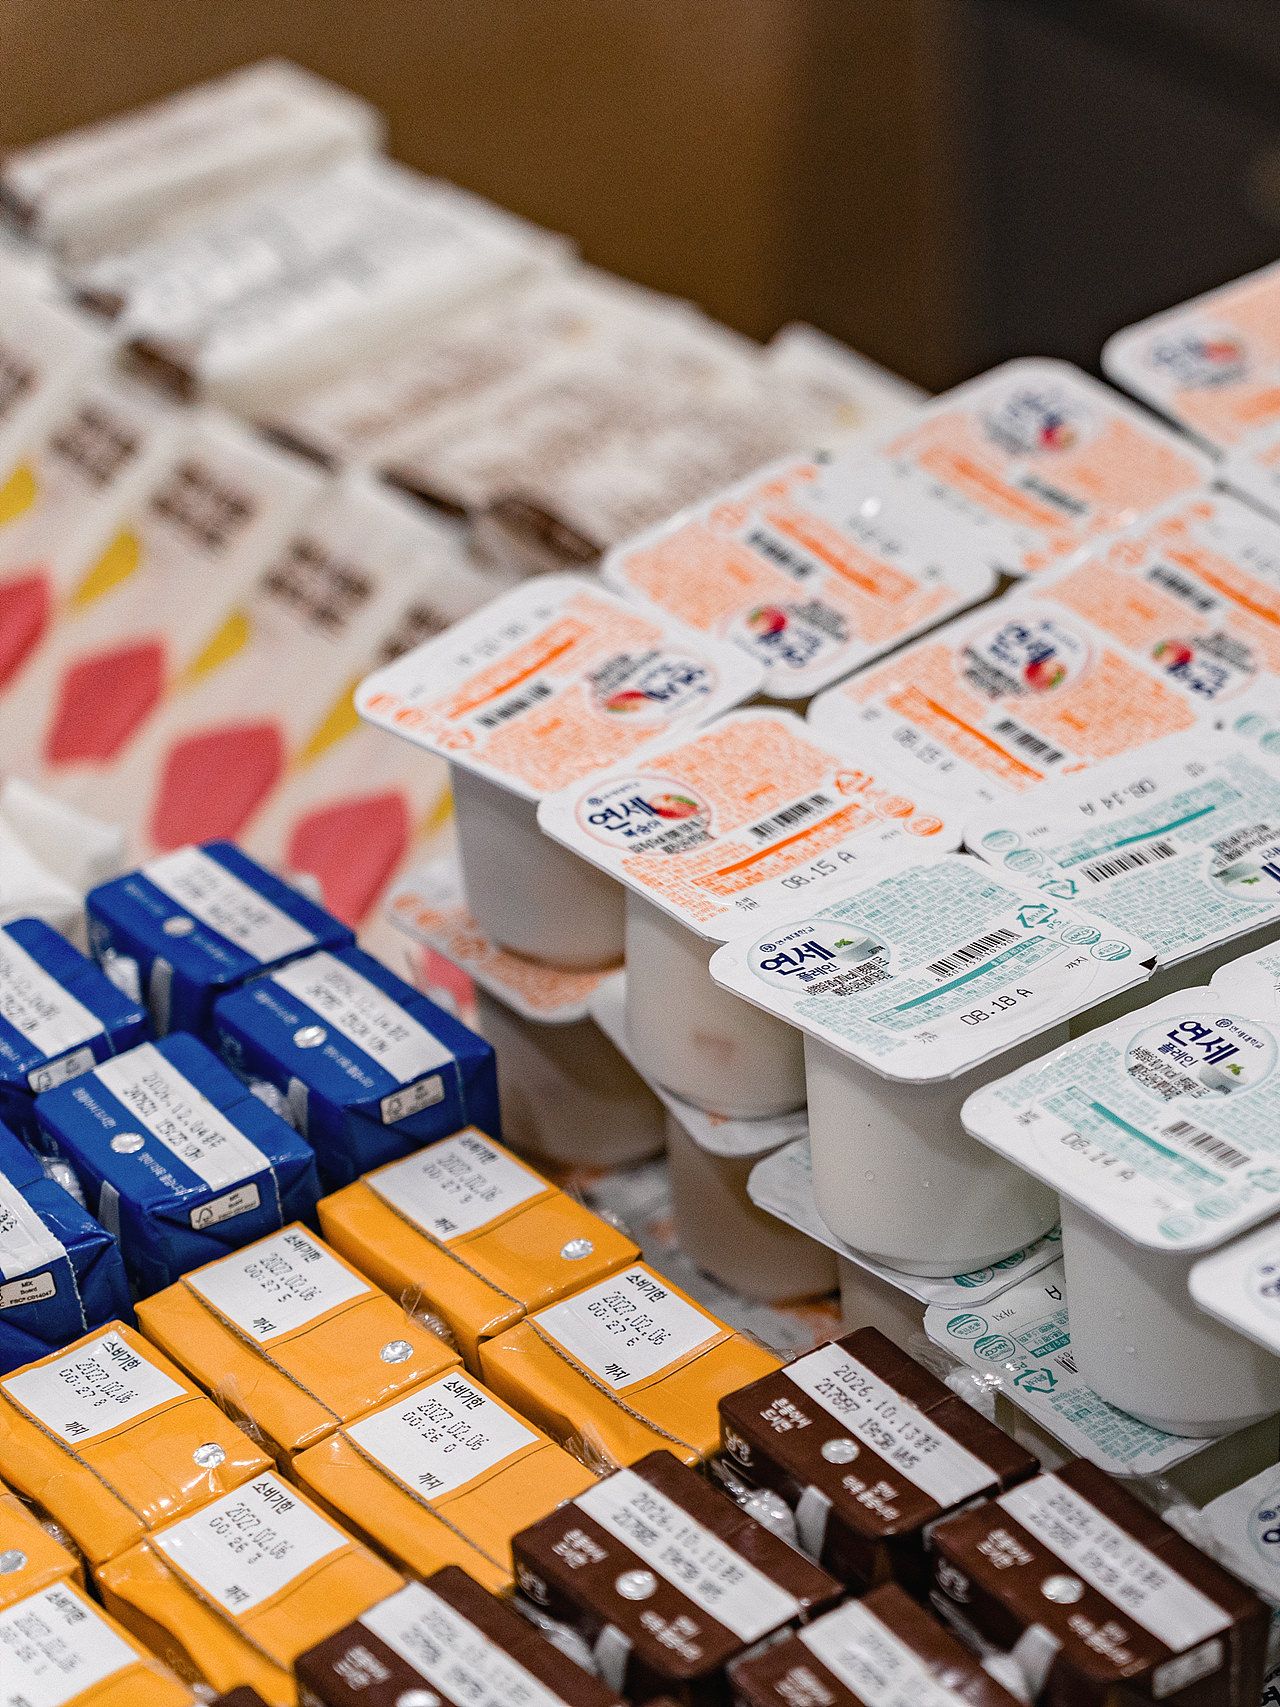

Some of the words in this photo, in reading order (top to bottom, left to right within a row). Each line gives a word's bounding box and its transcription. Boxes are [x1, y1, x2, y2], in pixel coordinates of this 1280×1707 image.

[589, 797, 660, 831] 연세
[781, 860, 838, 889] 08.15
[838, 852, 856, 864] A
[761, 941, 836, 976] 연세
[796, 962, 840, 983] 플레인
[1065, 956, 1089, 970] 까지
[961, 996, 1017, 1026] 08.18
[1016, 989, 1034, 998] A
[1168, 1021, 1239, 1065] 연세
[1229, 1026, 1265, 1049] 연세대학교
[1158, 1043, 1198, 1068] 플레인
[284, 1236, 321, 1263] 소비기한
[626, 1275, 667, 1303] 소비기한
[254, 1317, 277, 1334] 까지
[588, 1303, 627, 1335] 00:27
[603, 1291, 671, 1346] 2027.02.06
[992, 1308, 1017, 1322] 까지
[103, 1342, 141, 1372] 소비기한
[59, 1369, 96, 1399] 00:27
[76, 1358, 137, 1404] 2027.02.06
[605, 1363, 631, 1382] 까지
[443, 1381, 486, 1410] 소비기한
[66, 1421, 90, 1437] 까지
[402, 1412, 443, 1443] 00:26
[418, 1399, 489, 1451] 2027.02.06
[419, 1473, 444, 1491] 까지
[253, 1483, 295, 1515] 소비기한
[226, 1503, 293, 1560] 2027.02.06
[227, 1586, 250, 1603] 까지
